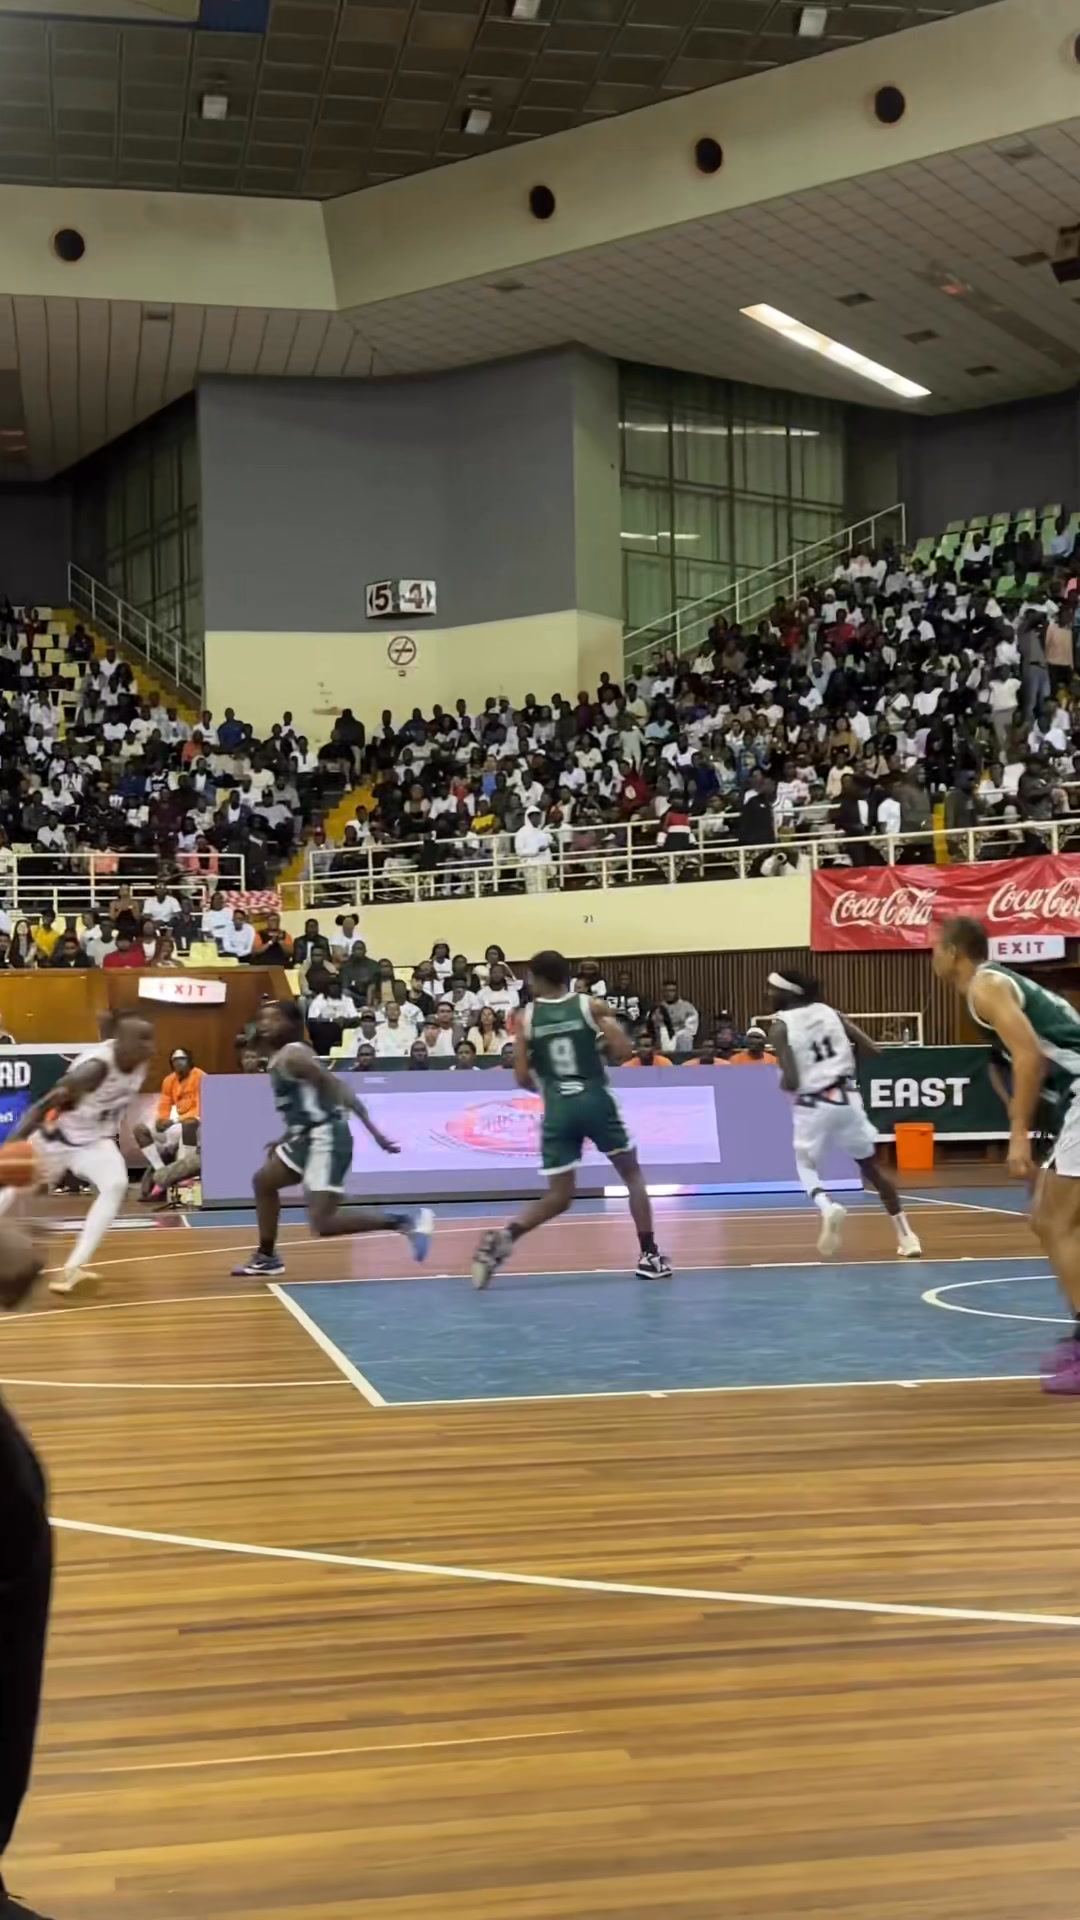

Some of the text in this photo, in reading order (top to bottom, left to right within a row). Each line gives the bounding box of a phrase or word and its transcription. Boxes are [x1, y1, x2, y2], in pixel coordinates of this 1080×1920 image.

[375, 584, 389, 611] 5
[404, 583, 424, 609] 4
[830, 885, 937, 928] Coca-Cola
[997, 941, 1046, 955] EXIT
[549, 1037, 578, 1076] 9
[811, 1036, 837, 1062] 11
[870, 1077, 970, 1108] EAST
